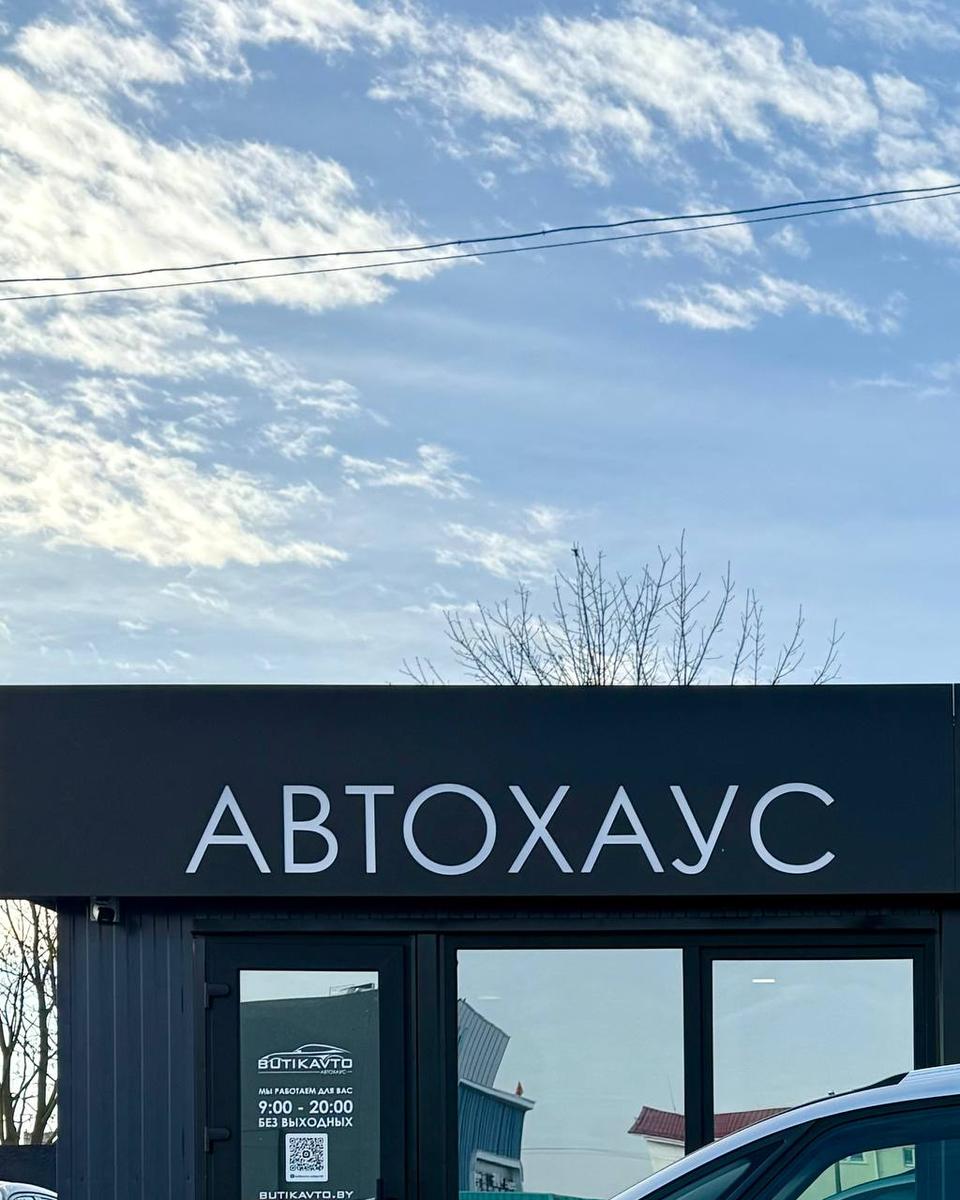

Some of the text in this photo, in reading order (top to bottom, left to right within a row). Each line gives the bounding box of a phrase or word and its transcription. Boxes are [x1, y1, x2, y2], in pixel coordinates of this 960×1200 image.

[185, 782, 836, 875] АВТОХАУС
[258, 1058, 353, 1070] BUTIKAVTO
[258, 1087, 273, 1095] МЫ
[274, 1087, 316, 1095] РАБОТАЕМ
[317, 1087, 335, 1095] ДЛЯ
[258, 1100, 292, 1114] 9:00
[309, 1100, 353, 1114] 20:00
[258, 1117, 353, 1128] БЕЗ ВЫХОДНЫХ
[259, 1191, 354, 1199] BUTIKAVTO.BY
